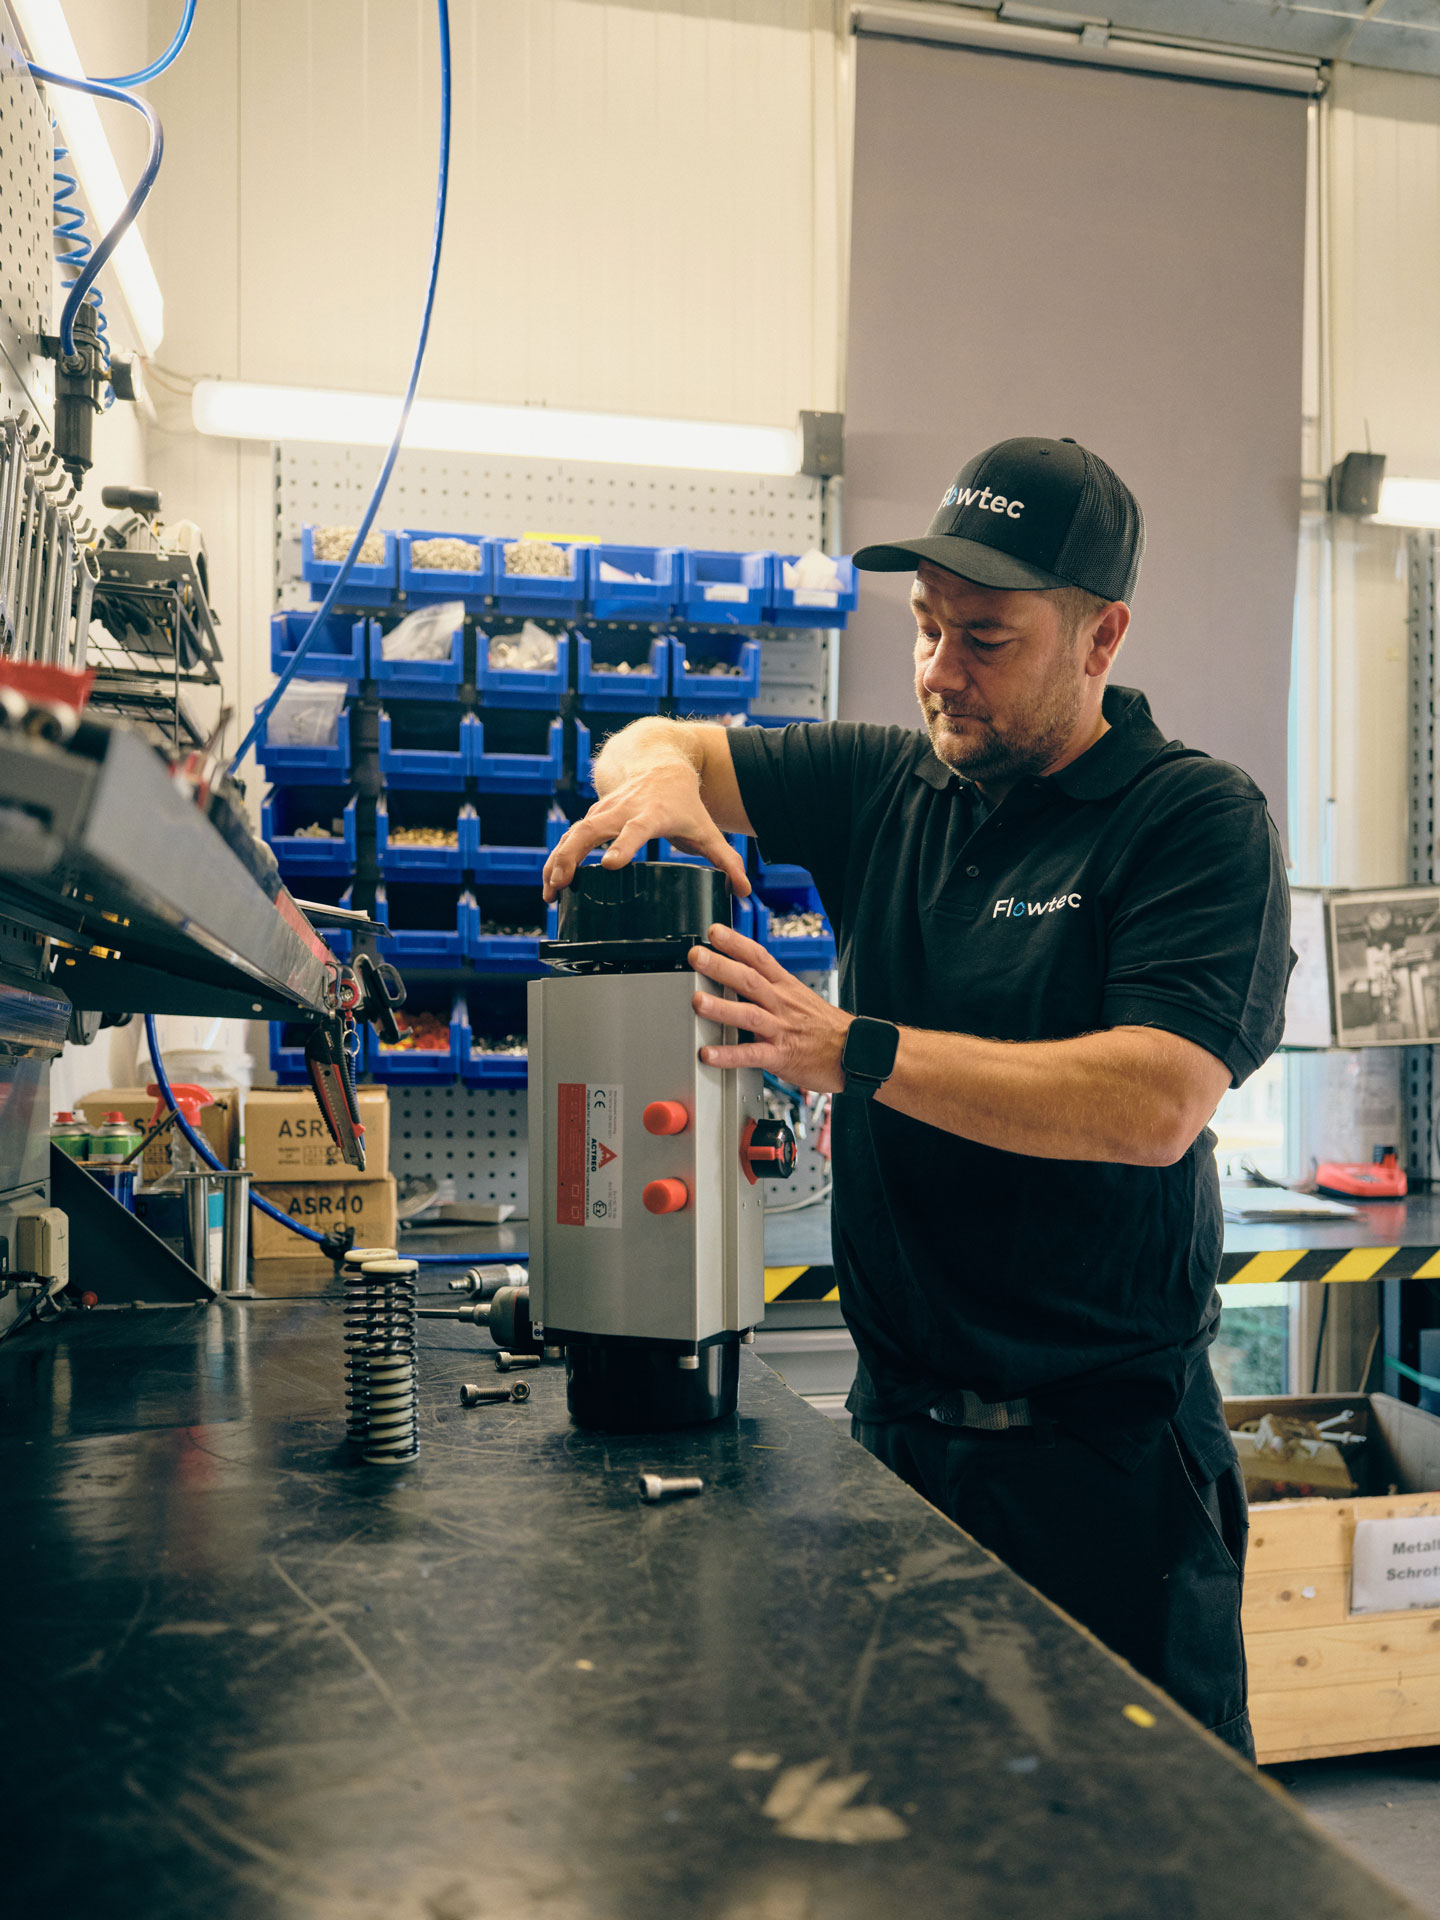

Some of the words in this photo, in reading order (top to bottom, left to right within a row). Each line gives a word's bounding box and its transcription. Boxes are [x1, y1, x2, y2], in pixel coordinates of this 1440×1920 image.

[992, 892, 1082, 919] Flowtec
[278, 1119, 331, 1138] ASR
[288, 1195, 362, 1214] ASR40
